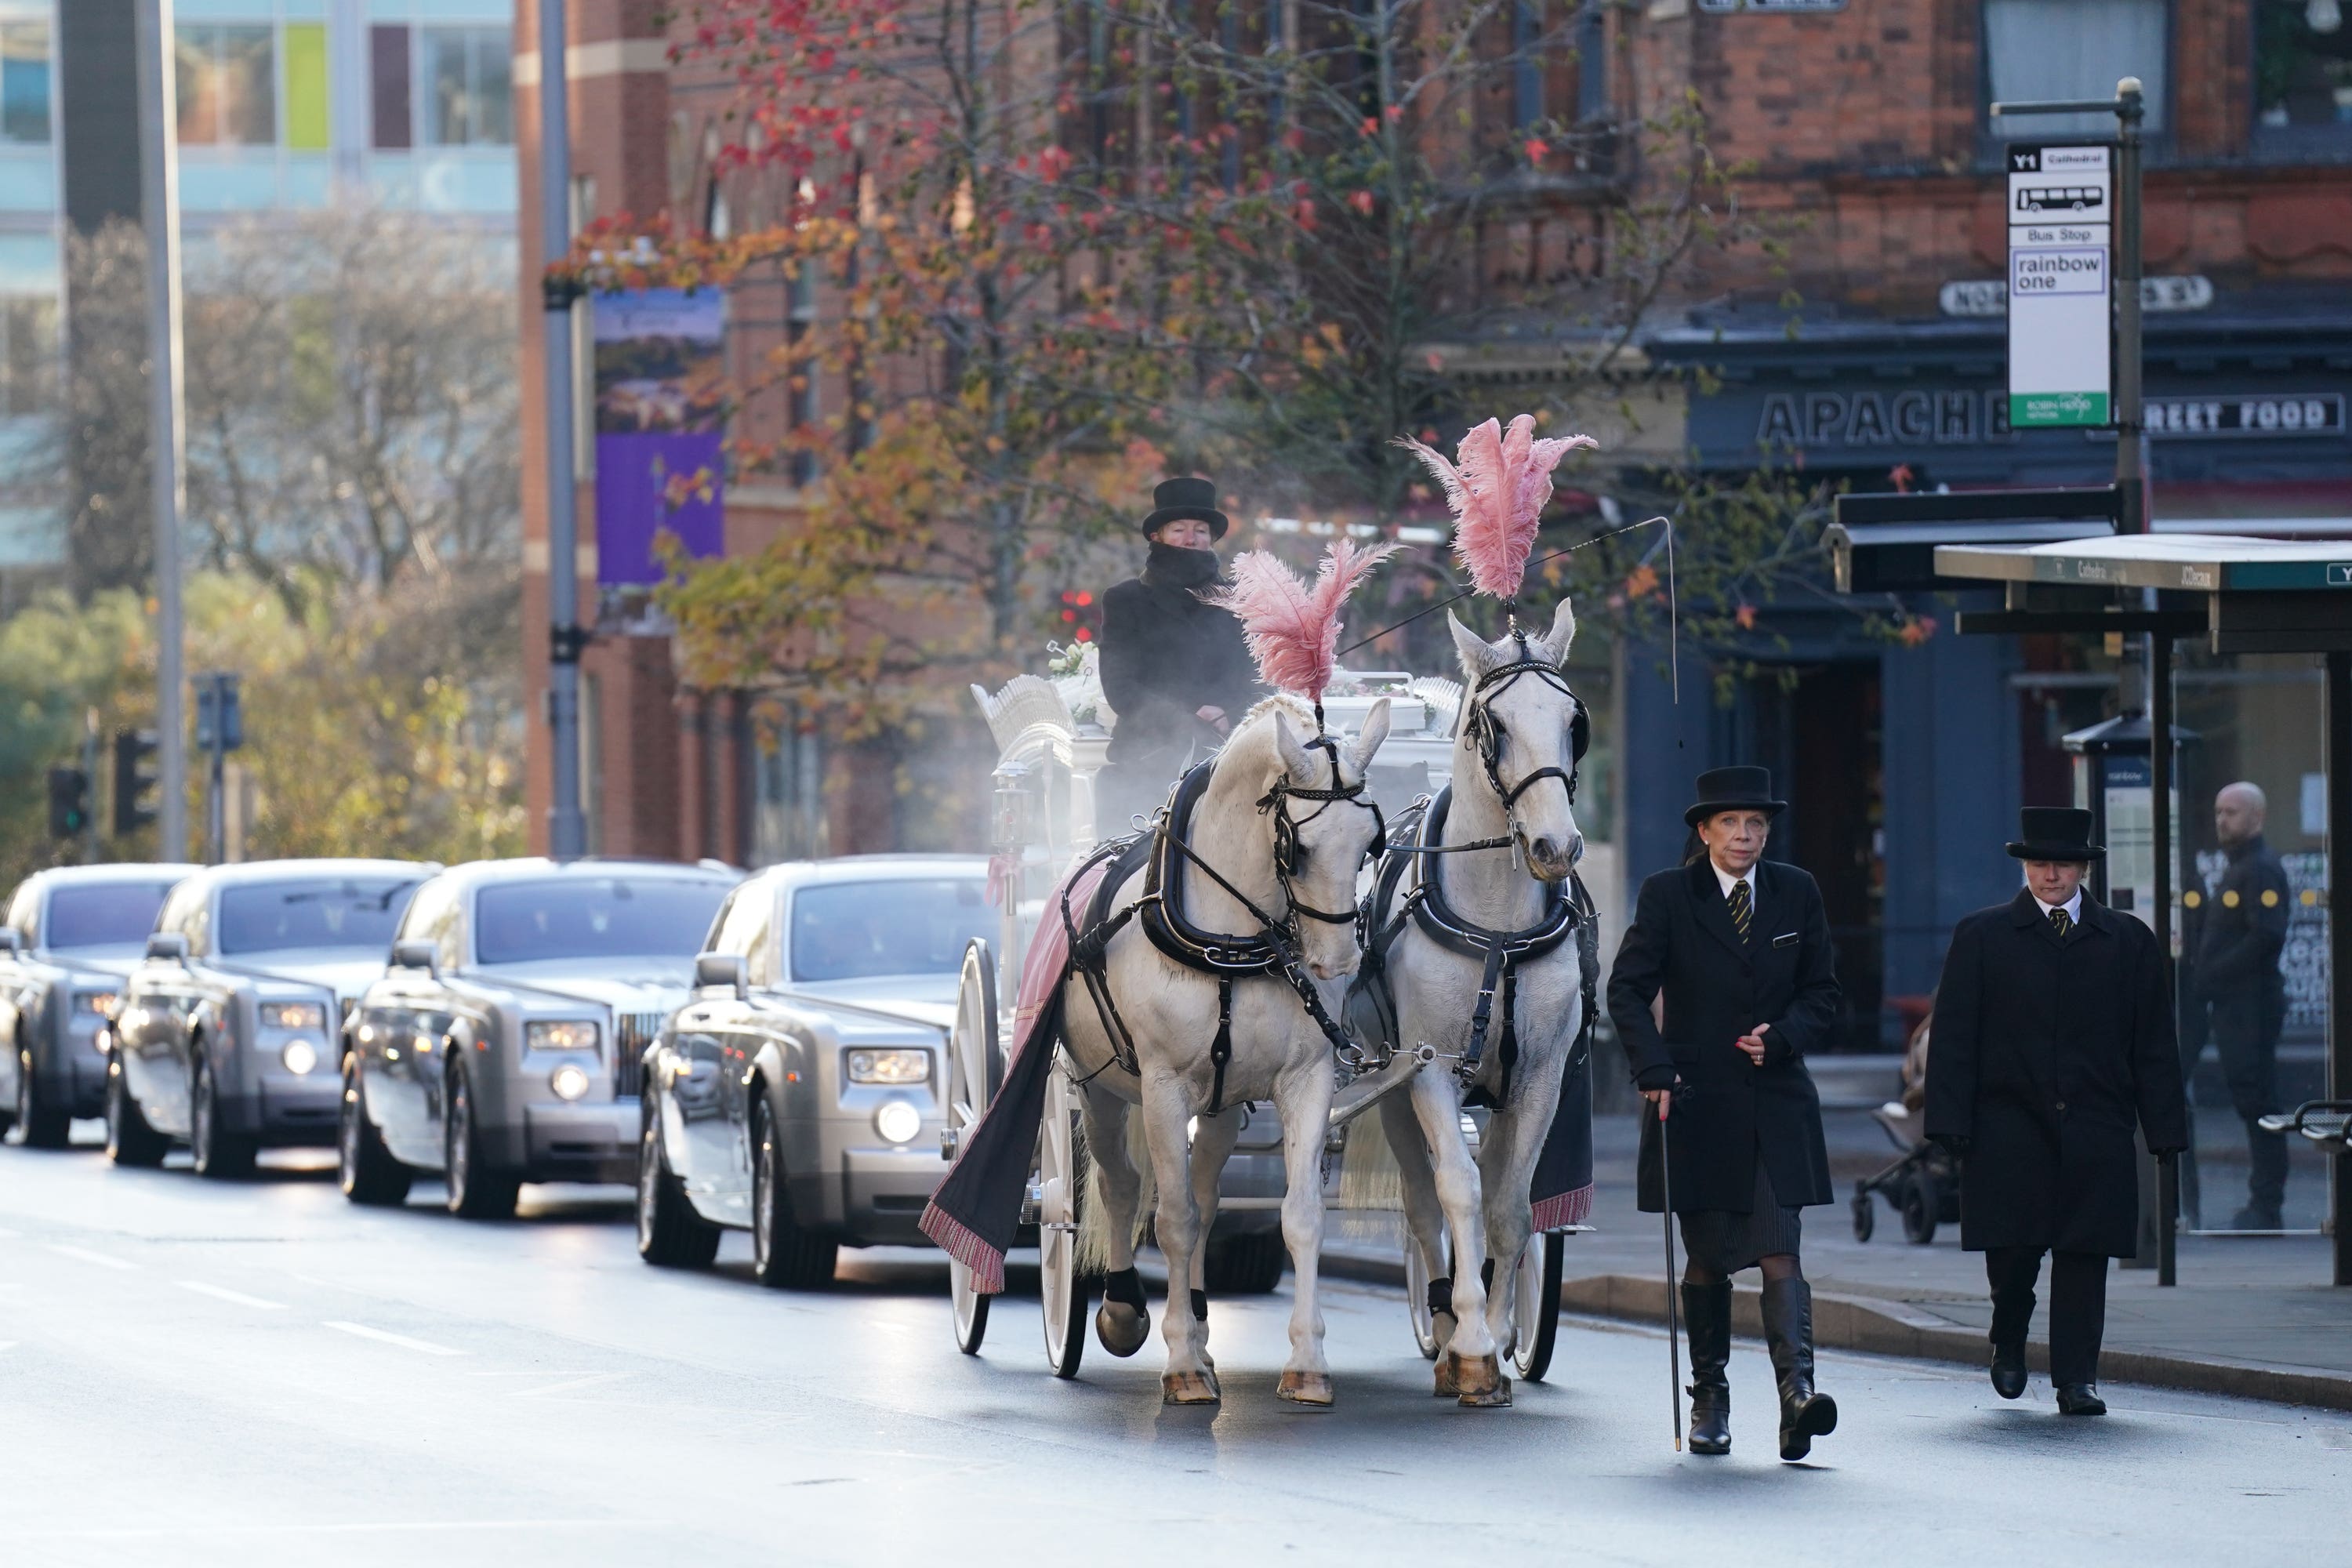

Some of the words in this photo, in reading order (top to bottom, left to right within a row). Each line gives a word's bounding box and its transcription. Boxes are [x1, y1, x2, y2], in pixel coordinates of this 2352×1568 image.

[2013, 154, 2037, 169] Y1
[2048, 153, 2101, 164] Cathedral
[2027, 229, 2054, 241] Bus
[2060, 228, 2092, 242] Stop
[2019, 255, 2100, 273] rainbow
[2019, 276, 2056, 289] one
[1756, 390, 2021, 445] APACHE
[2143, 401, 2222, 431] REET
[2240, 400, 2326, 430] FOOD
